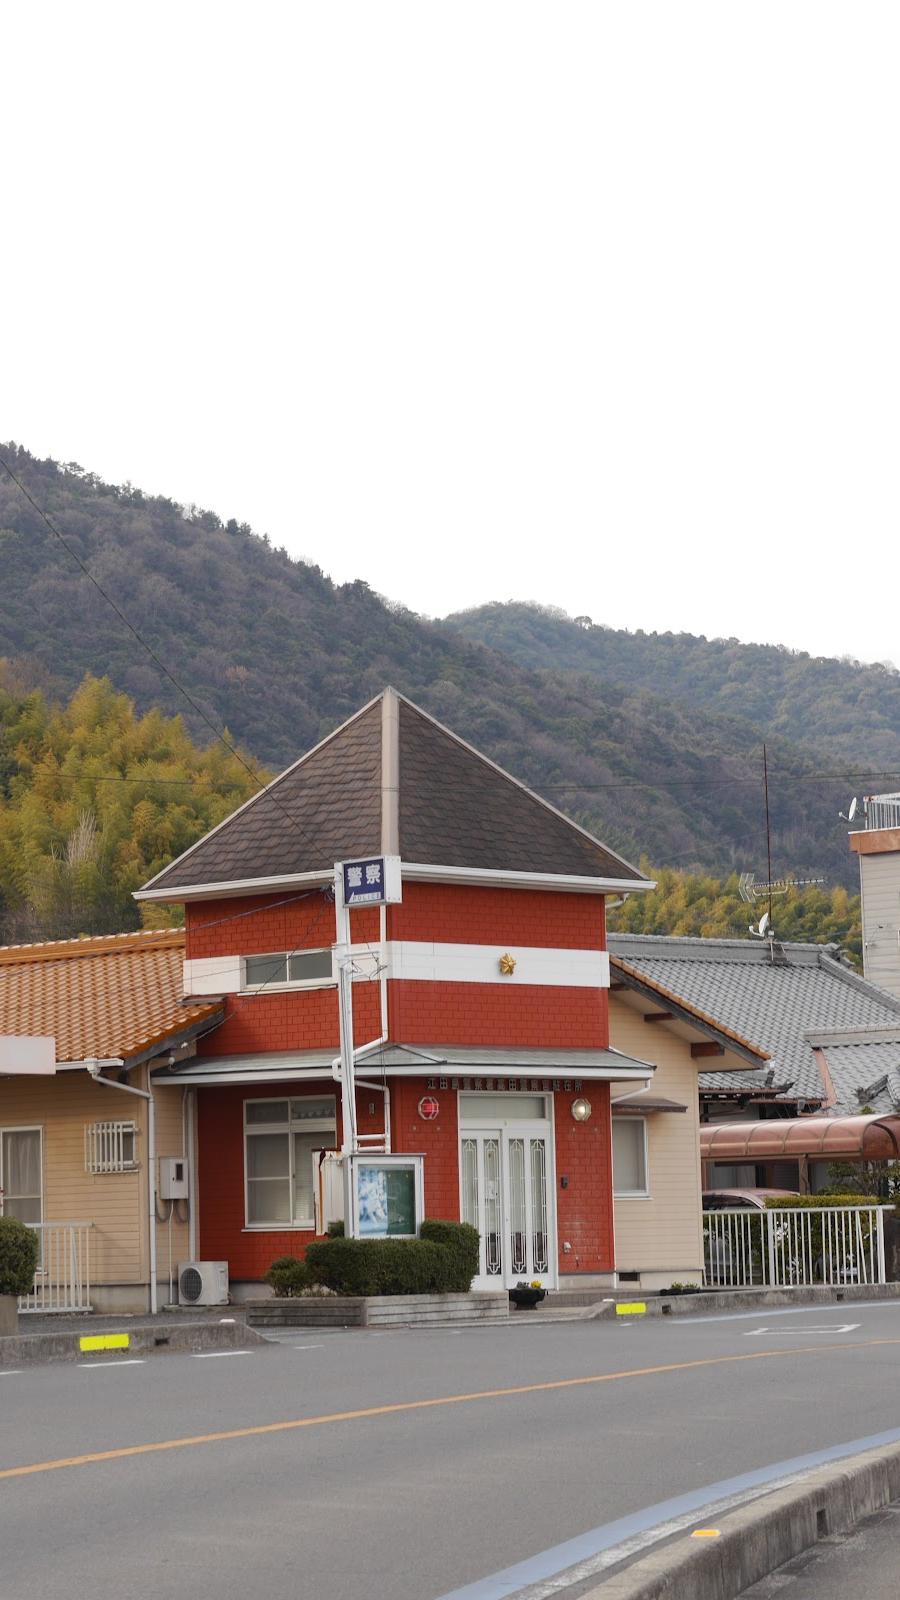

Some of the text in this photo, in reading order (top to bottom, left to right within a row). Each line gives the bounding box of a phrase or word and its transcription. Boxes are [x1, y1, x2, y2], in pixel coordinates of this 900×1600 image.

[347, 864, 382, 887] 警察
[352, 893, 380, 902] POLICE
[427, 1077, 583, 1092] 江田島田駐在所
